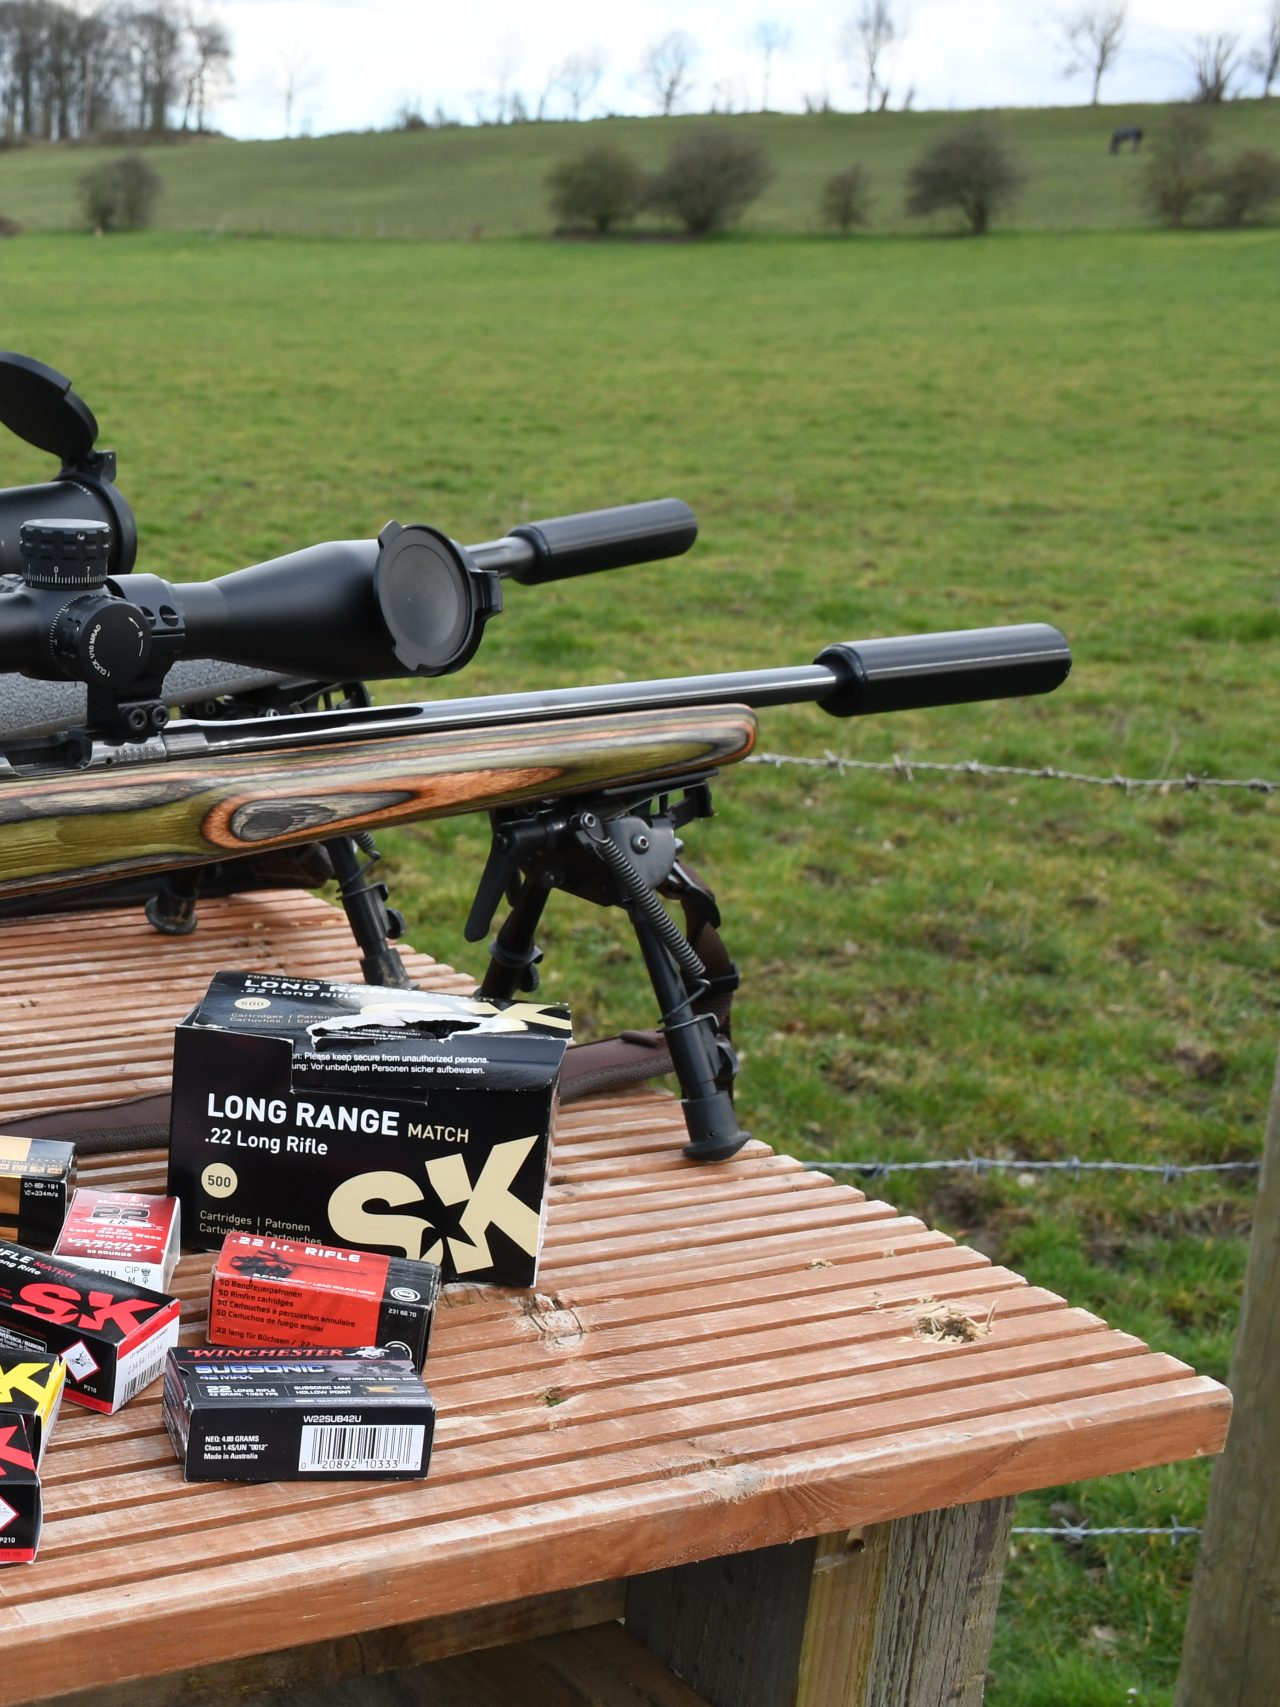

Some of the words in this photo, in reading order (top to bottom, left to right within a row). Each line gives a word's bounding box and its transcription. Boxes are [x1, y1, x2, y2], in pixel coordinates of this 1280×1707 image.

[90, 624, 102, 645] MRAD
[92, 659, 107, 676] CLICK
[244, 979, 320, 991] LONG
[271, 989, 314, 997] Long
[304, 1052, 331, 1061] Please
[332, 1054, 352, 1062] keep
[382, 1054, 399, 1062] from
[402, 1054, 453, 1063] unauthorized
[454, 1056, 489, 1065] persons.
[310, 1062, 324, 1071] Vor
[325, 1063, 370, 1073] unbefugten
[371, 1064, 409, 1072] Personen
[410, 1065, 434, 1073] sicher
[207, 1093, 287, 1124] LONG
[295, 1101, 401, 1137] RANGE
[407, 1123, 470, 1144] MATCH
[204, 1128, 231, 1146] .22
[236, 1130, 281, 1155] Long
[286, 1135, 329, 1156] Rifle
[206, 1173, 231, 1189] 500
[327, 1134, 541, 1275] SK
[92, 1206, 150, 1220] 22
[200, 1210, 252, 1225] Cartridges
[265, 1218, 310, 1231] Patronen
[67, 1238, 157, 1251] VARMINT
[232, 1237, 264, 1247] .22
[305, 1247, 361, 1263] RIFLE
[17, 1264, 41, 1275] Rifle
[33, 1261, 76, 1279] MATCH
[230, 1291, 255, 1302] Rimfire
[257, 1294, 294, 1307] cartridges
[11, 1283, 162, 1338] SK
[230, 1301, 270, 1314] Cartouches
[279, 1309, 319, 1322] percussion
[320, 1315, 356, 1327] annulaire
[300, 1322, 324, 1332] anular
[187, 1349, 343, 1358] WINCHESTER
[194, 1365, 325, 1374] SUBSONIC
[303, 1415, 362, 1423] W22SUB42U
[230, 1452, 258, 1460] Australia
[322, 1460, 357, 1469] 20892
[364, 1460, 398, 1469] 10333
